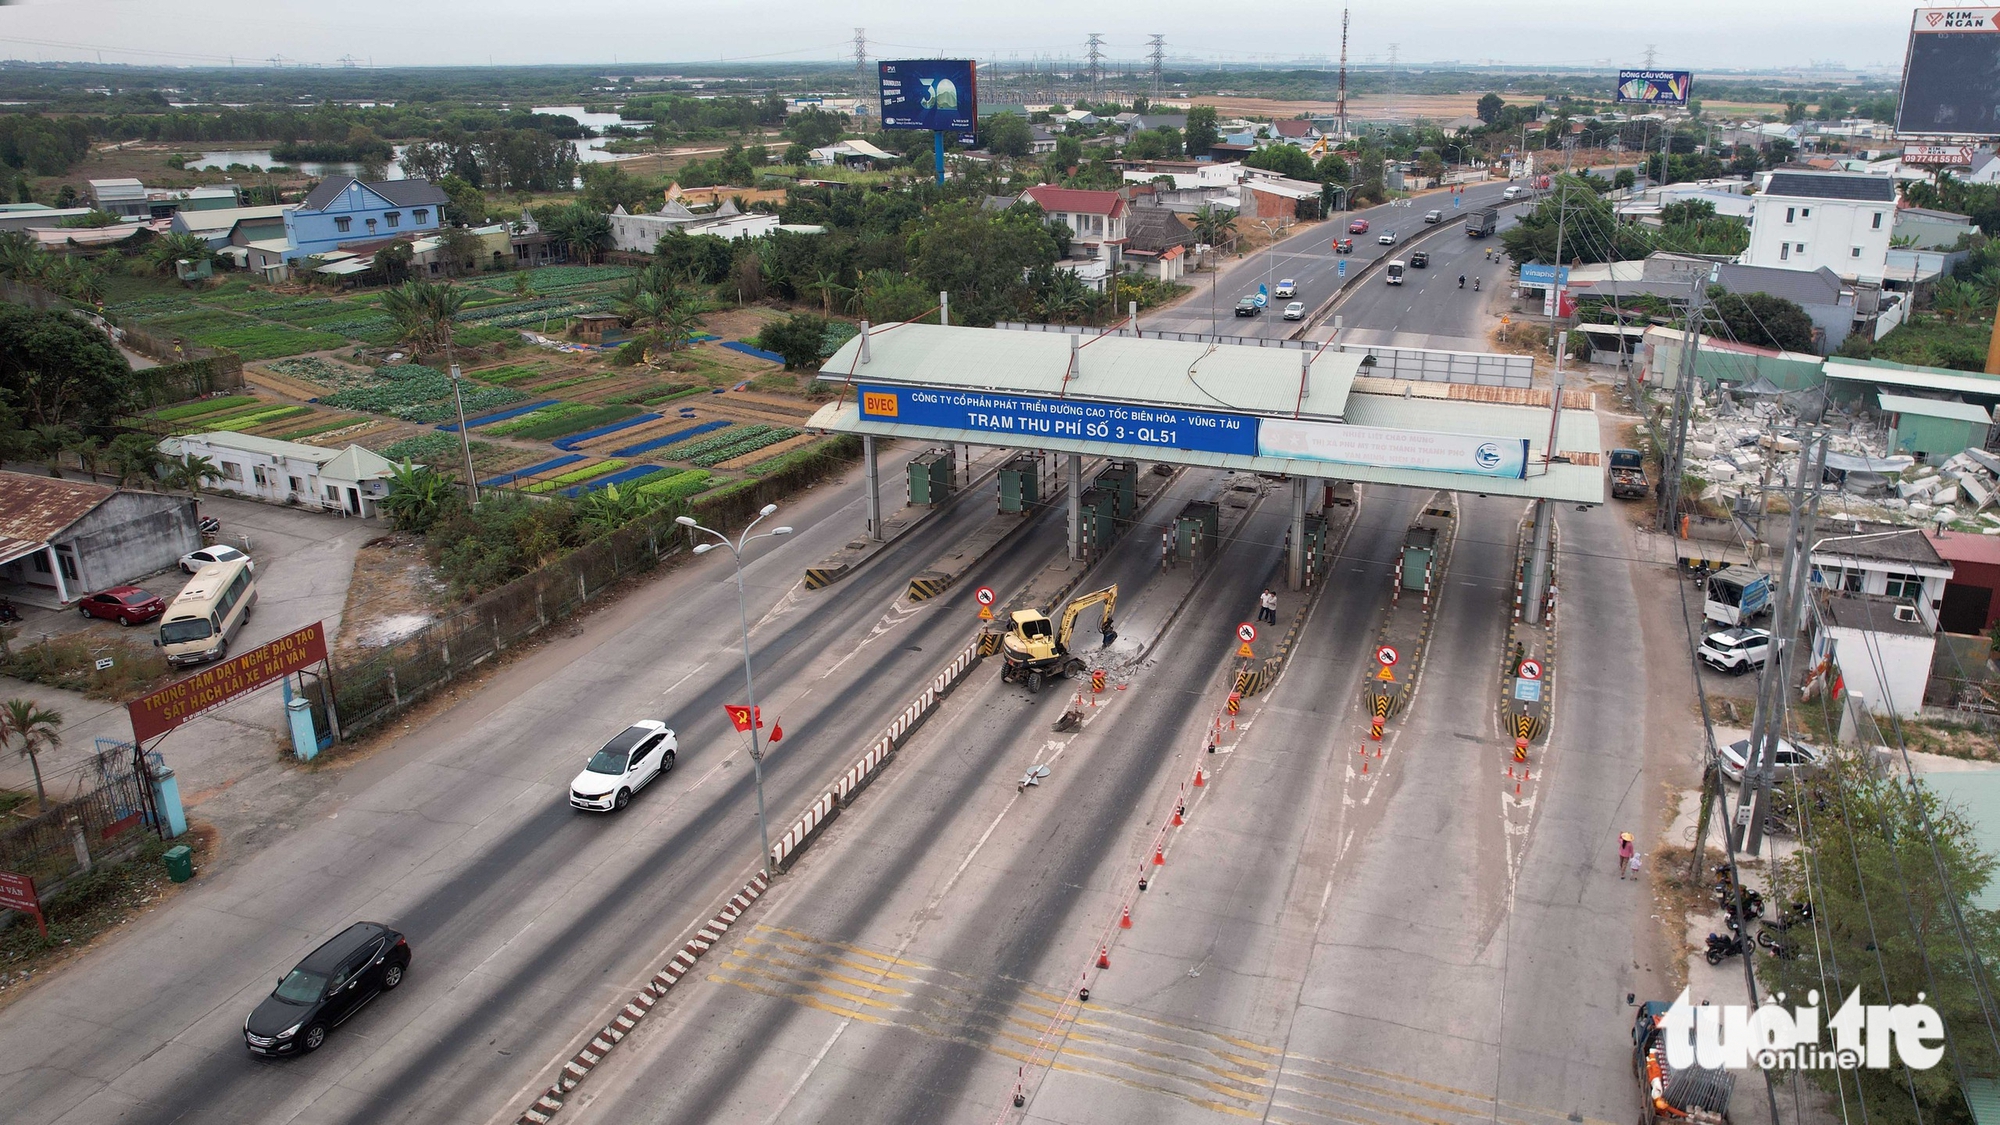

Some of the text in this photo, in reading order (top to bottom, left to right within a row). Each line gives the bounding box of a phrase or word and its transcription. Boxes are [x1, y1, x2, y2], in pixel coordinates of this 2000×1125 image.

[1525, 269, 1564, 278] vinaphoe
[867, 397, 894, 412] BVEC
[912, 392, 938, 403] CÔNG
[940, 395, 951, 404] TY
[994, 399, 1017, 410] PHÁT
[1020, 399, 1048, 412] TRIỂN
[1050, 404, 1083, 416] ĐƯỜNG
[1086, 408, 1105, 418] CAO
[1109, 408, 1128, 419] TỐC
[1131, 410, 1154, 421] BIÊN
[1156, 412, 1177, 424] HÒA
[1188, 415, 1216, 428] VŨNG
[1220, 417, 1240, 429] TÀU
[968, 413, 1013, 430] TRẠM
[1018, 417, 1050, 432] THU
[1055, 418, 1081, 435] PHÍ
[1086, 420, 1109, 437] SỐ
[1116, 427, 1125, 439] 3
[1137, 428, 1177, 444] QL51
[144, 685, 186, 711] TRUNG
[188, 674, 214, 692] TÂM
[216, 661, 238, 680] DẠY
[241, 644, 269, 669] NGHỀ
[272, 638, 293, 655] ĐÀO
[295, 628, 315, 646] TẠO
[164, 700, 186, 721] SÁT
[191, 685, 222, 704] HẠCH
[224, 675, 244, 693] LÁI
[246, 669, 260, 684] XE
[265, 656, 284, 675] HẢI
[286, 648, 306, 665] VÂN
